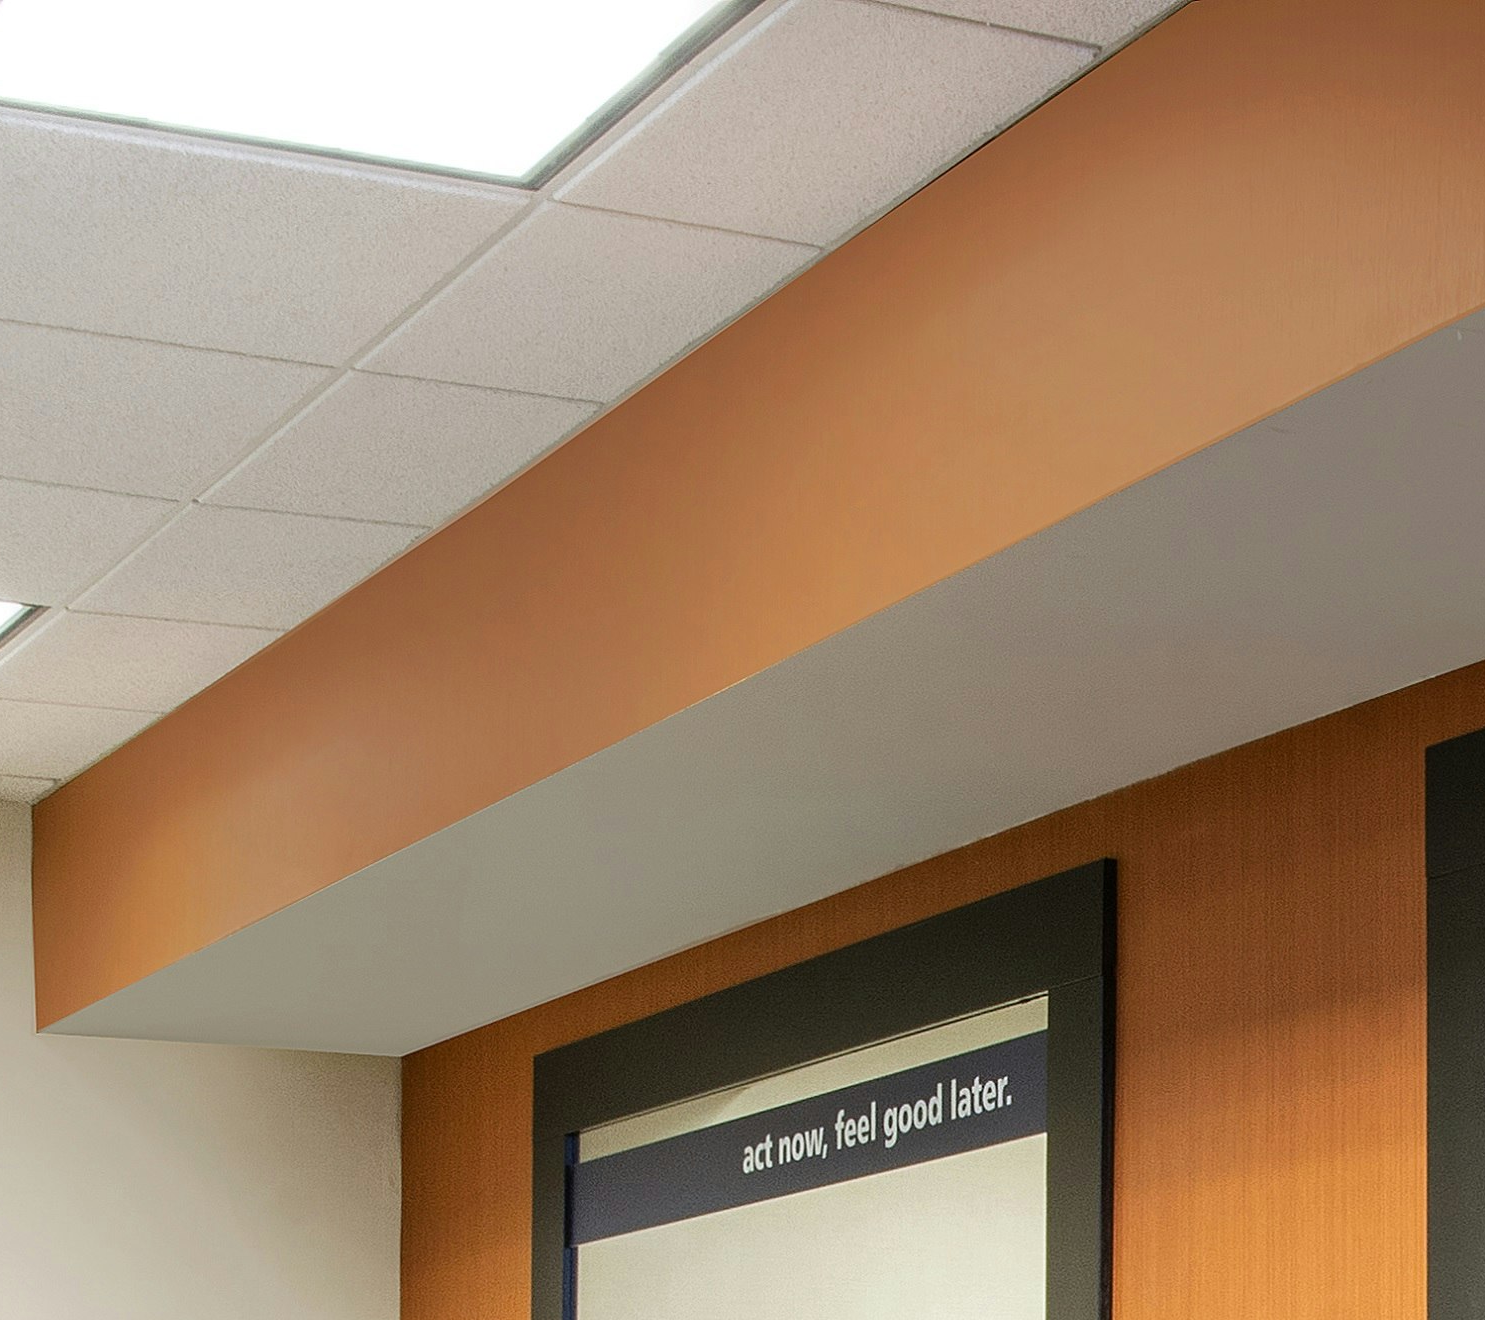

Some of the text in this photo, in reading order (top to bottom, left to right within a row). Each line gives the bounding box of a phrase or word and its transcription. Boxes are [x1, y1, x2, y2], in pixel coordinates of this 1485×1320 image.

[743, 1076, 1012, 1174] act now, feel good later.
